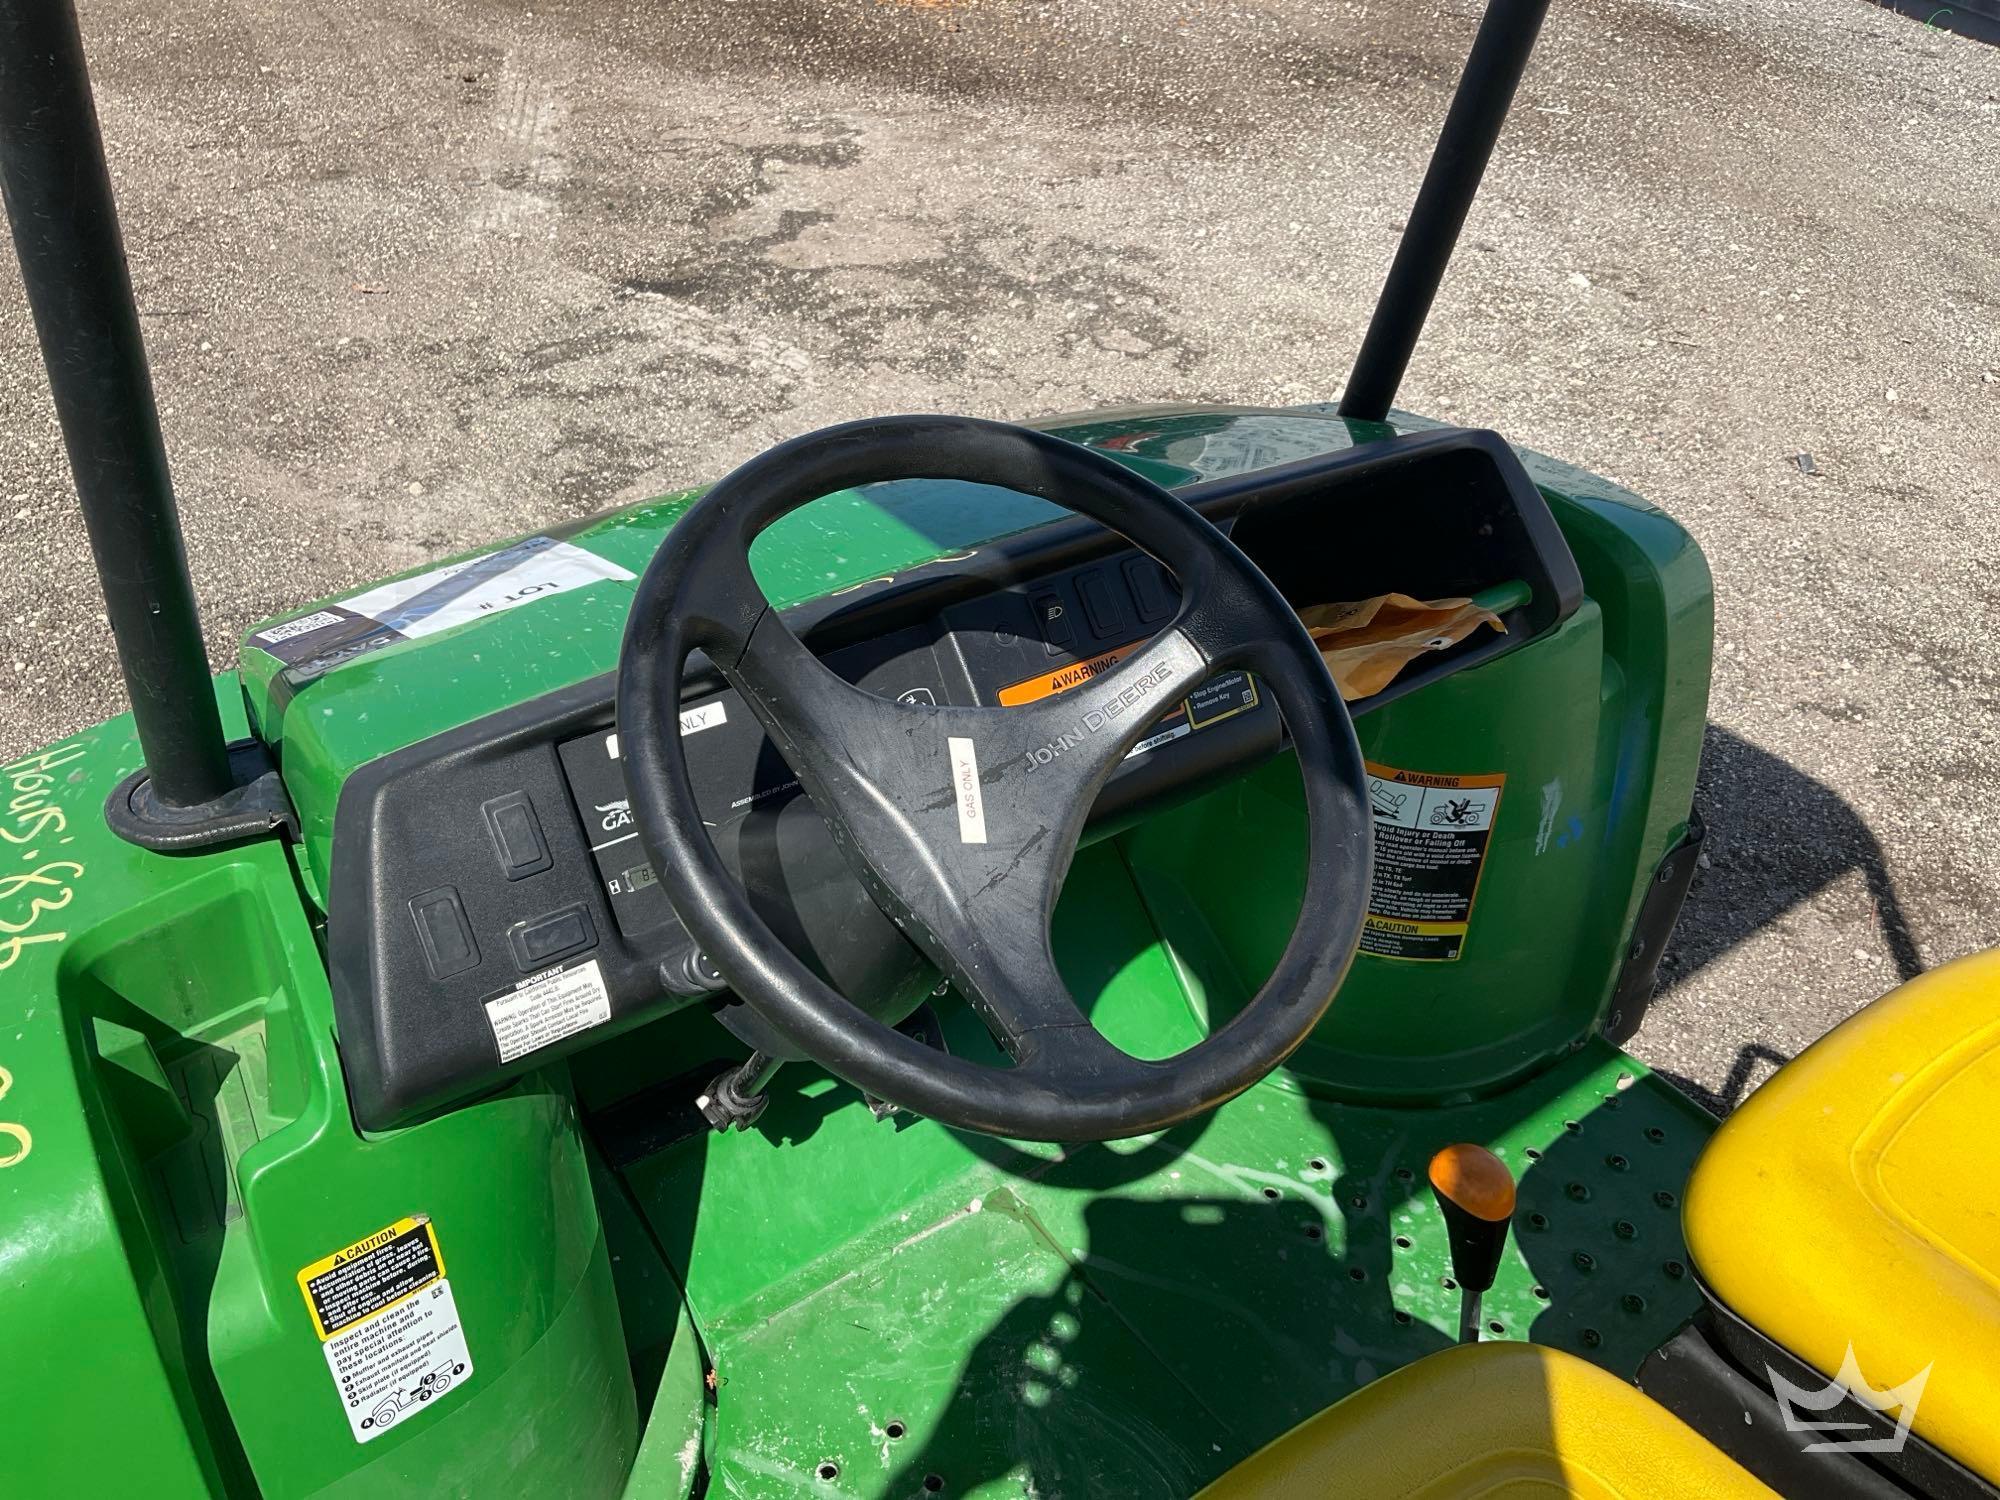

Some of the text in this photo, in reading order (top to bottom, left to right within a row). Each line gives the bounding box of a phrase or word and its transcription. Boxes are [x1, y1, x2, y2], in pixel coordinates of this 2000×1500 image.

[504, 582, 560, 602] LOT
[1061, 655, 1119, 686] WARNING
[1193, 690, 1206, 700] Stop
[1196, 692, 1230, 709] Remove Key
[680, 711, 706, 731] NLY
[1025, 661, 1173, 773] JOHN DEERE
[1135, 741, 1153, 752] before
[960, 760, 976, 818] GAS ONLY
[1408, 773, 1460, 787] WARNING
[1379, 833, 1412, 843] Rollover
[1425, 839, 1452, 847] Falling
[1397, 828, 1420, 837] Injury
[1376, 921, 1418, 934] CAUTION
[516, 965, 564, 990] IMPORTANT
[346, 1227, 397, 1260] CAUTION
[316, 1245, 395, 1285] Avoid equipment fires.
[319, 1266, 365, 1291] Accumulation
[366, 1260, 373, 1268] of
[397, 1238, 419, 1252] leaves
[321, 1288, 334, 1298] and
[335, 1279, 353, 1291] other
[355, 1268, 376, 1281] debris
[396, 1249, 411, 1260] near
[412, 1242, 423, 1251] hot
[332, 1285, 358, 1300] moving
[359, 1275, 376, 1288] parts
[377, 1268, 390, 1277] can
[391, 1257, 410, 1270] cause
[417, 1247, 431, 1256] fire.
[325, 1295, 350, 1311] Inspect
[352, 1280, 380, 1298] machine
[328, 1291, 376, 1317] and after use.
[329, 1311, 346, 1323] Shut
[347, 1306, 356, 1314] off
[358, 1295, 381, 1309] engine
[382, 1286, 394, 1297] and
[396, 1277, 413, 1289] allow
[332, 1312, 361, 1329] machine
[371, 1298, 385, 1310] cool
[386, 1287, 407, 1301] before
[409, 1271, 436, 1289] cleaning.
[330, 1300, 419, 1349] Inspect and clean the
[334, 1311, 414, 1357] entire machine and
[336, 1310, 432, 1367] pay special attention to
[339, 1336, 405, 1373] these locations:
[352, 1331, 433, 1378] Muffler and exhaust pipes
[355, 1324, 457, 1386] Exhaust manifold and heat shields
[358, 1383, 372, 1394] Skid
[374, 1374, 390, 1387] plate
[400, 1350, 431, 1371] equipped)
[361, 1360, 429, 1402] Radiator (if equipped)
